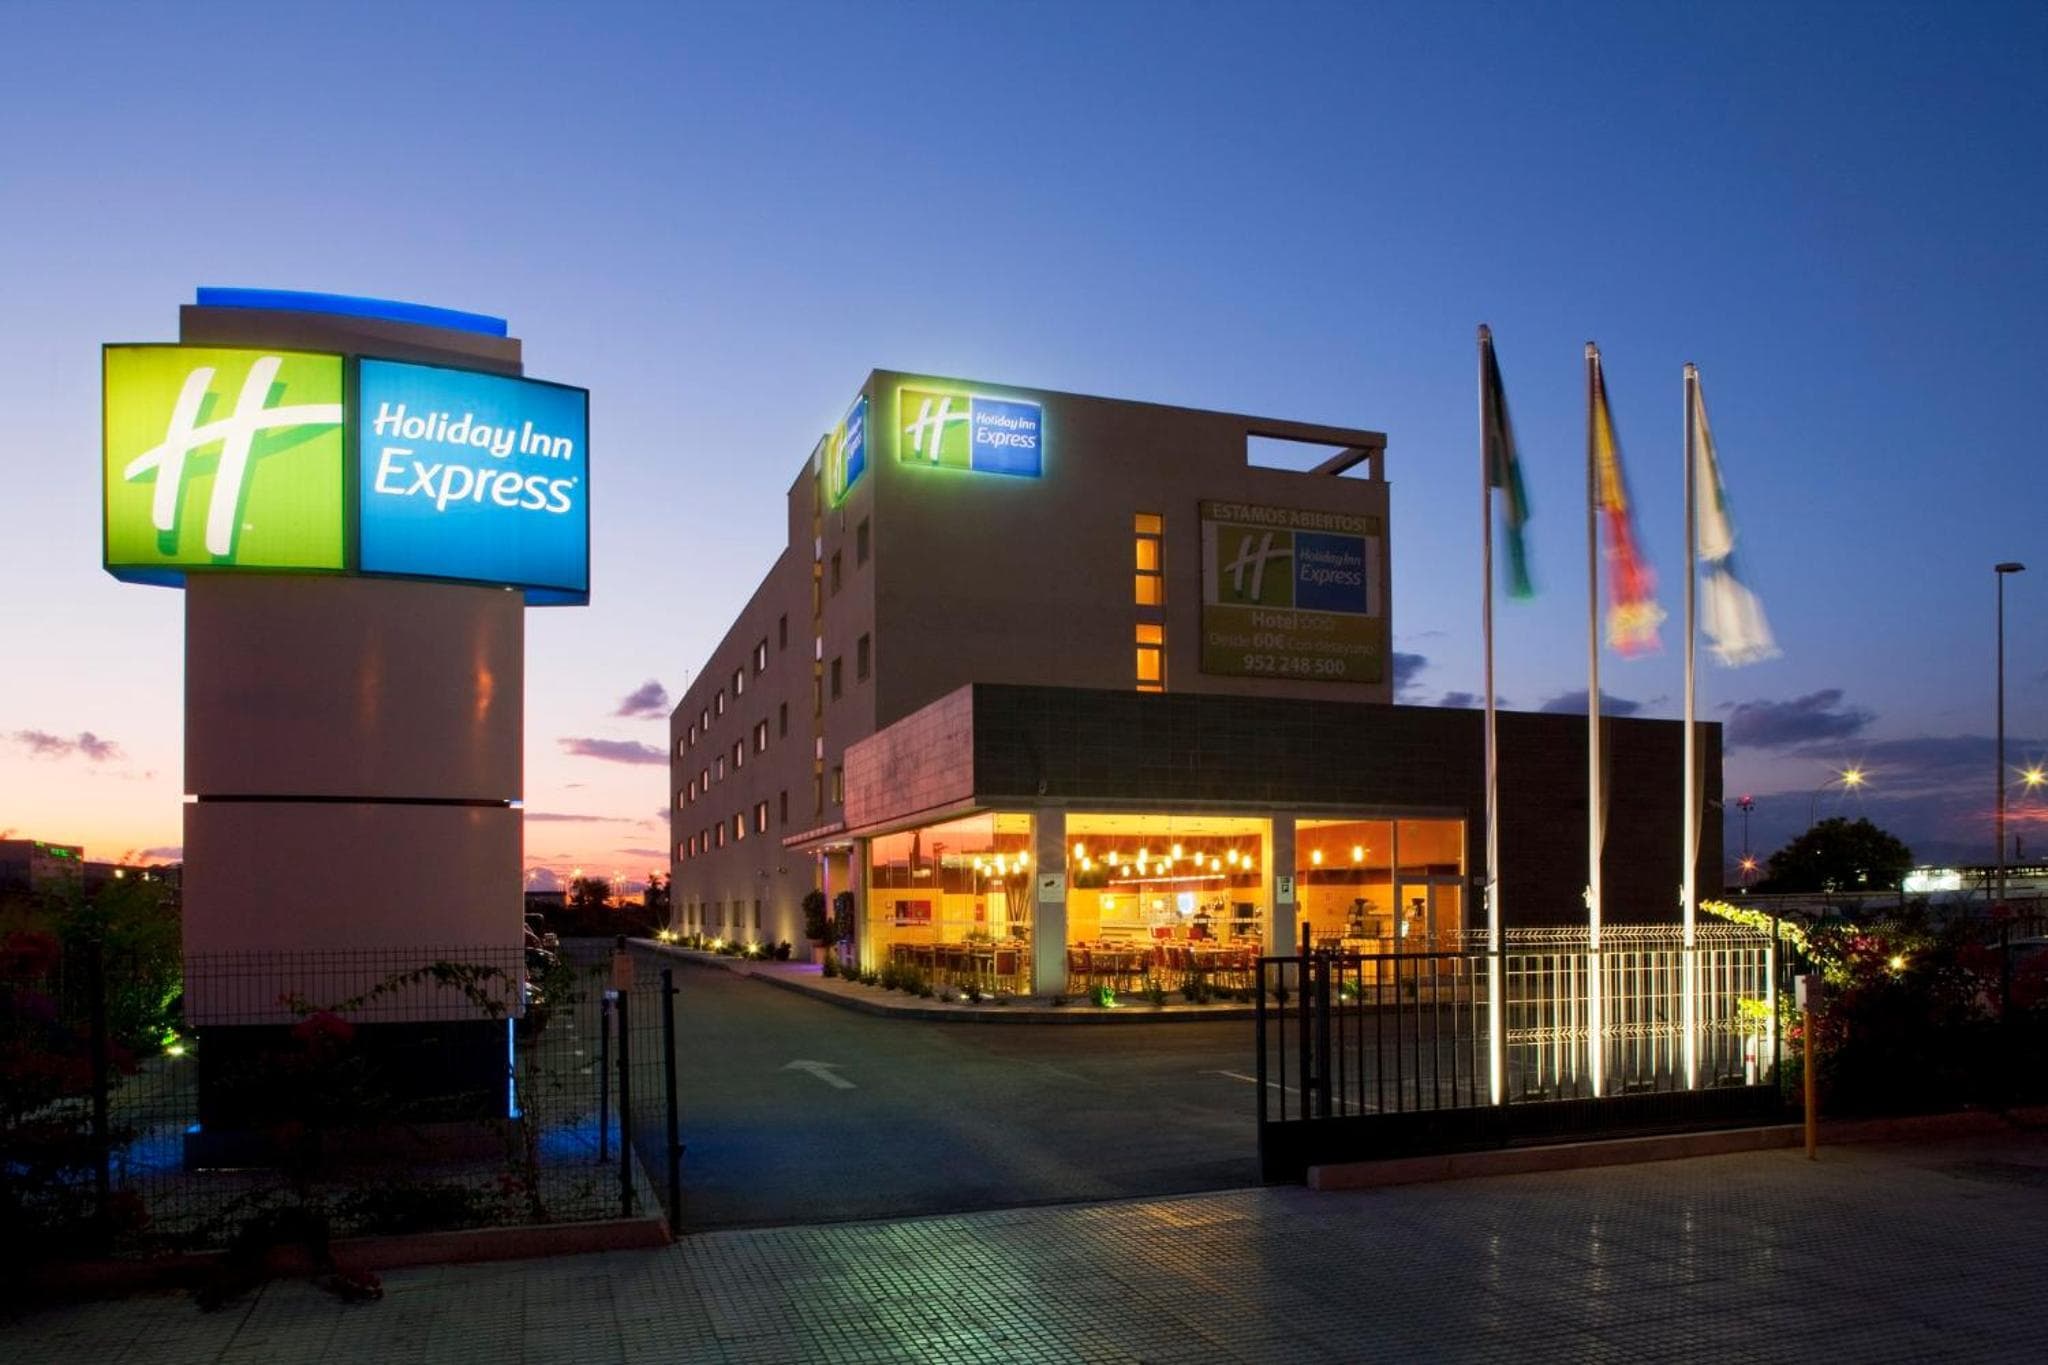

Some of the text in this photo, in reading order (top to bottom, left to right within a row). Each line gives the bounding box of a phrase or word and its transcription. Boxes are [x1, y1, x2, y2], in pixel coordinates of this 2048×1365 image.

[373, 402, 573, 461] Holiday Inn
[976, 412, 1036, 431] Holiday Inn
[976, 427, 1037, 448] Express
[374, 448, 573, 514] Express
[1213, 503, 1287, 524] ESTAMOS
[1300, 545, 1361, 566] Holiday Inn
[1300, 564, 1361, 586] Express
[1252, 611, 1297, 630] Hotel
[1243, 654, 1345, 676] 952 248 500
